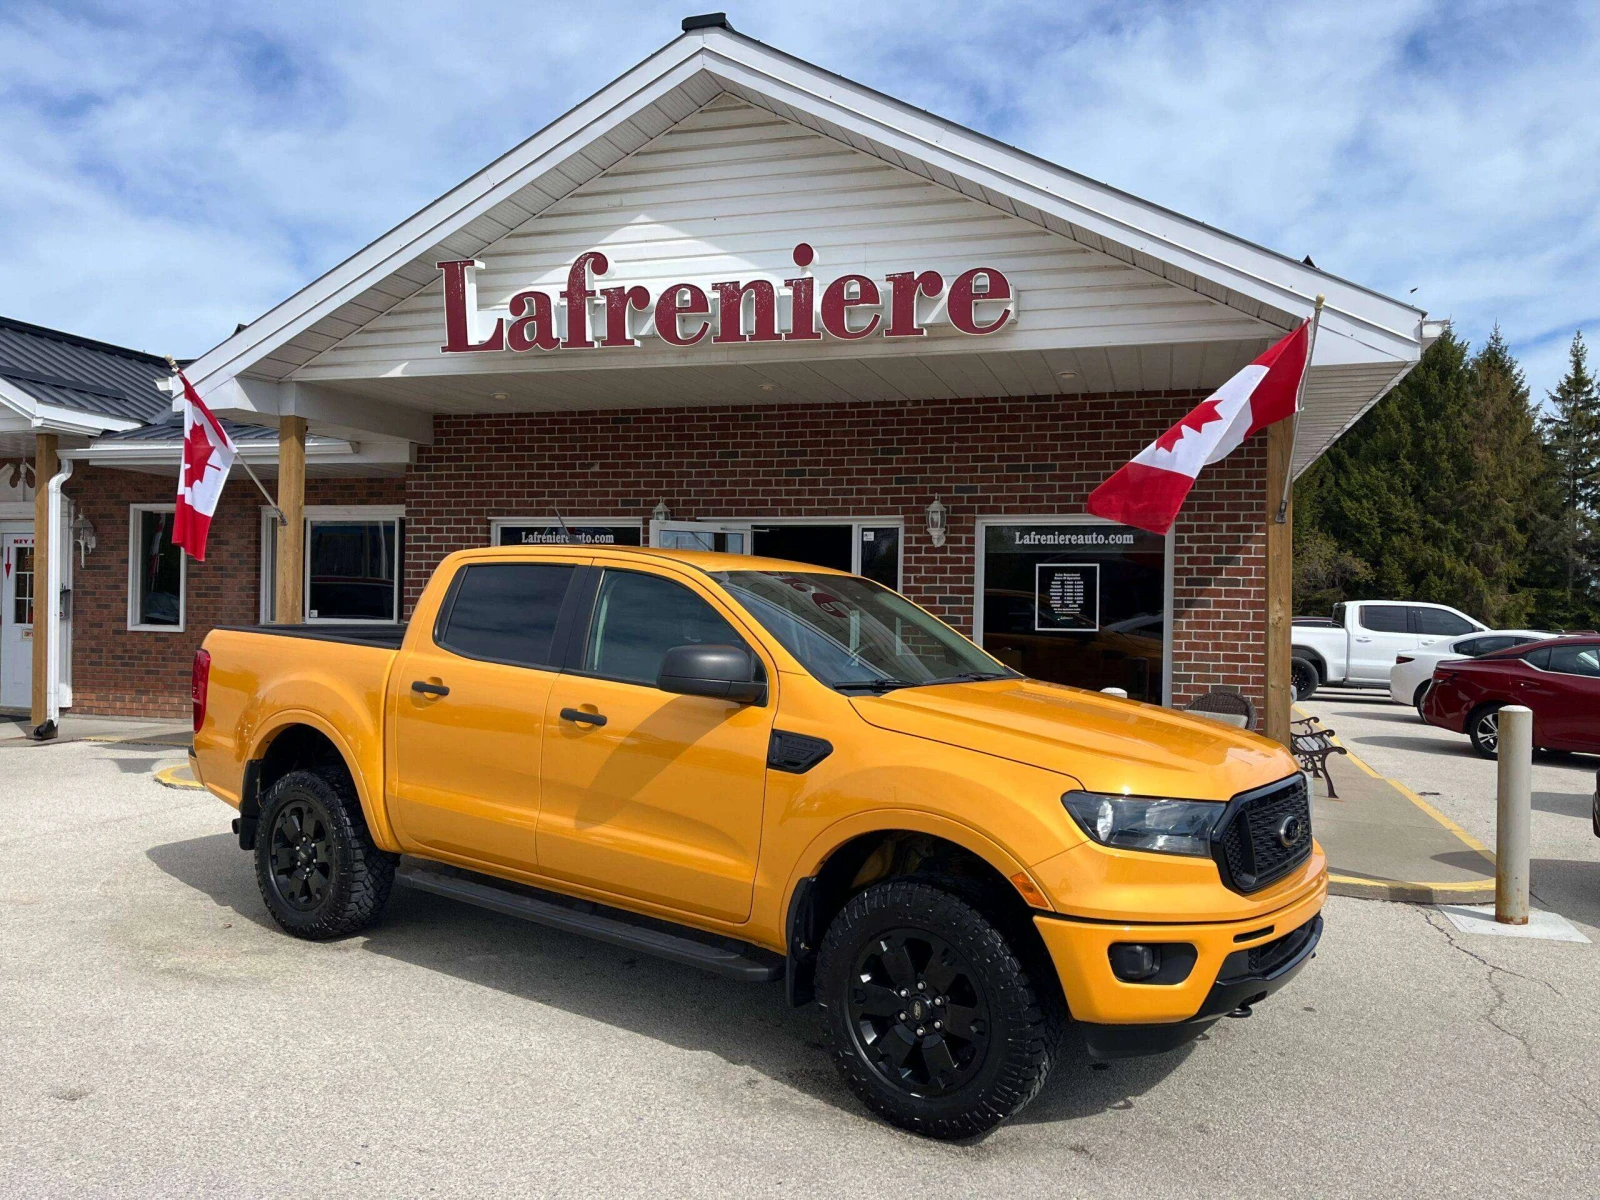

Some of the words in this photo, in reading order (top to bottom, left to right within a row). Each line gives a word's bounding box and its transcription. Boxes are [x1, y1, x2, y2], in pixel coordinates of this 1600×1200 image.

[436, 243, 1012, 353] Lafreniere
[521, 531, 614, 543] Lafreniereto.com
[1015, 531, 1134, 544] Lafreniereauto.com
